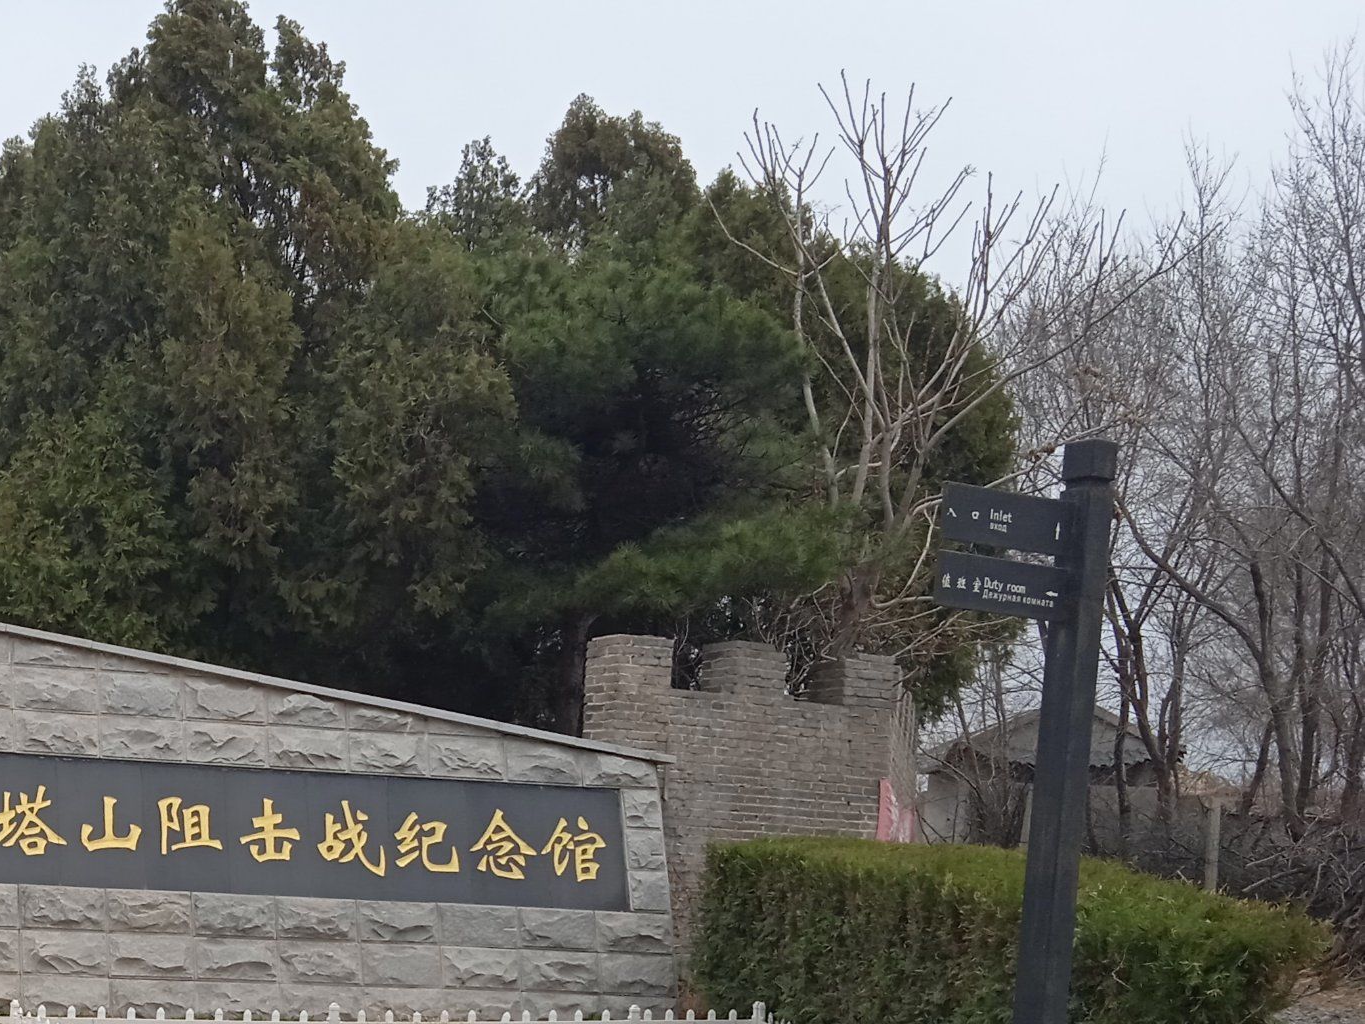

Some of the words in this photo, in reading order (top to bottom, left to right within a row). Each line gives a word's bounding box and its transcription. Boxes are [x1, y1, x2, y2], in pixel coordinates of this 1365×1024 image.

[947, 507, 980, 520] 入口
[990, 508, 1012, 523] Inlet
[942, 573, 981, 593] 值班室
[984, 577, 1004, 592] Duty
[1007, 583, 1026, 594] room
[982, 589, 1021, 602] Дежурная
[1022, 596, 1054, 608] комната
